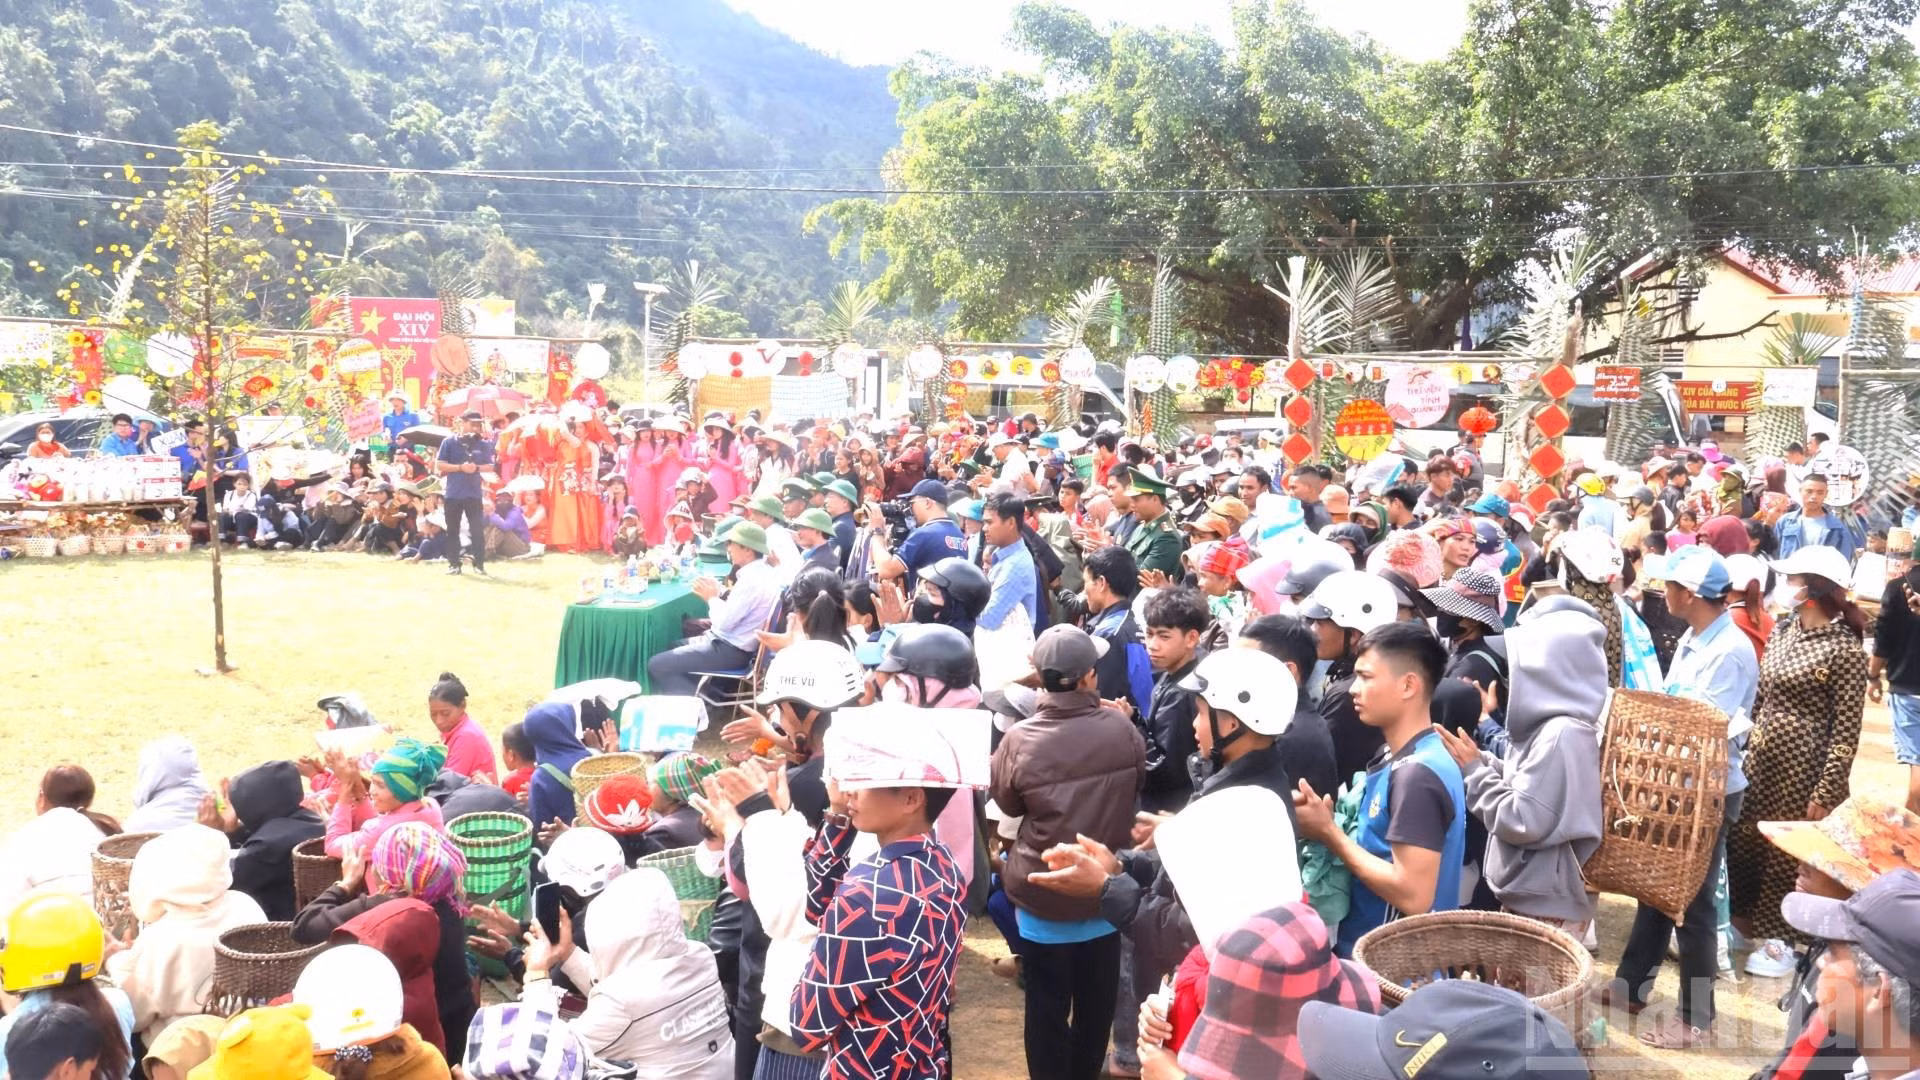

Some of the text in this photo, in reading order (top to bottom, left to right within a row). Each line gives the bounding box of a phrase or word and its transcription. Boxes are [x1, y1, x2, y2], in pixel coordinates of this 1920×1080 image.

[393, 311, 435, 324] ĐẠI HỘI
[398, 323, 430, 337] XIV
[1682, 386, 1696, 396] XIV
